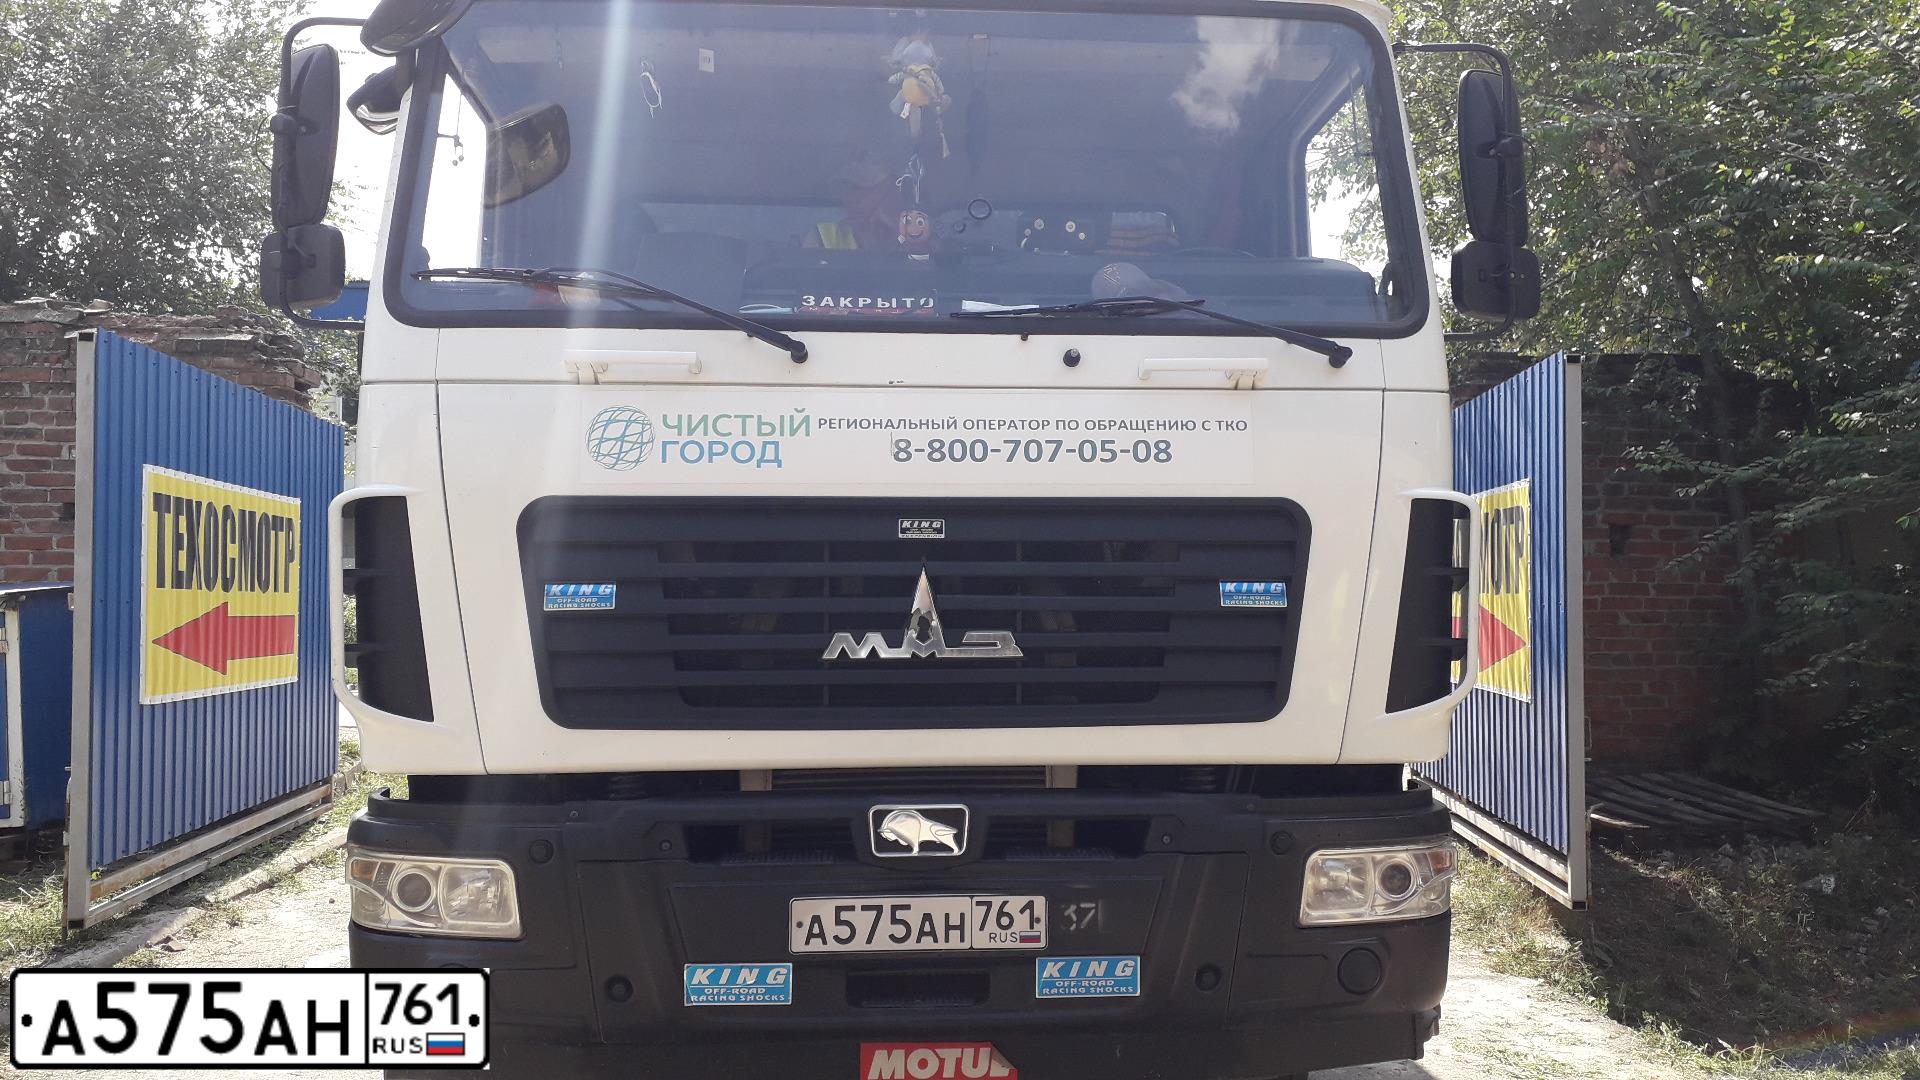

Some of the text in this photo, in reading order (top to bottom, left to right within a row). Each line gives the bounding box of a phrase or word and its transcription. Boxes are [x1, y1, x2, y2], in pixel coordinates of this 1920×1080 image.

[801, 295, 935, 308] ЗАКРЫТО
[662, 407, 811, 437] ЧИСТЫЙ
[818, 416, 1248, 433] РЕГИОНАЛЬНЫЙ ОПЕРАТОР ПО ОБРАЩЕНИЮ С ТКО
[661, 440, 783, 468] ГОРОД
[893, 438, 1173, 463] 8-800-707-05-08
[901, 520, 942, 528] KING
[152, 491, 296, 594] ТЕХОСМОТР
[549, 584, 613, 596] KING
[1225, 582, 1283, 593] KING
[975, 900, 1035, 931] 761
[989, 932, 1018, 943] RUS
[691, 968, 788, 985] KING
[1042, 960, 1136, 978] KING
[1042, 987, 1086, 995] RACING
